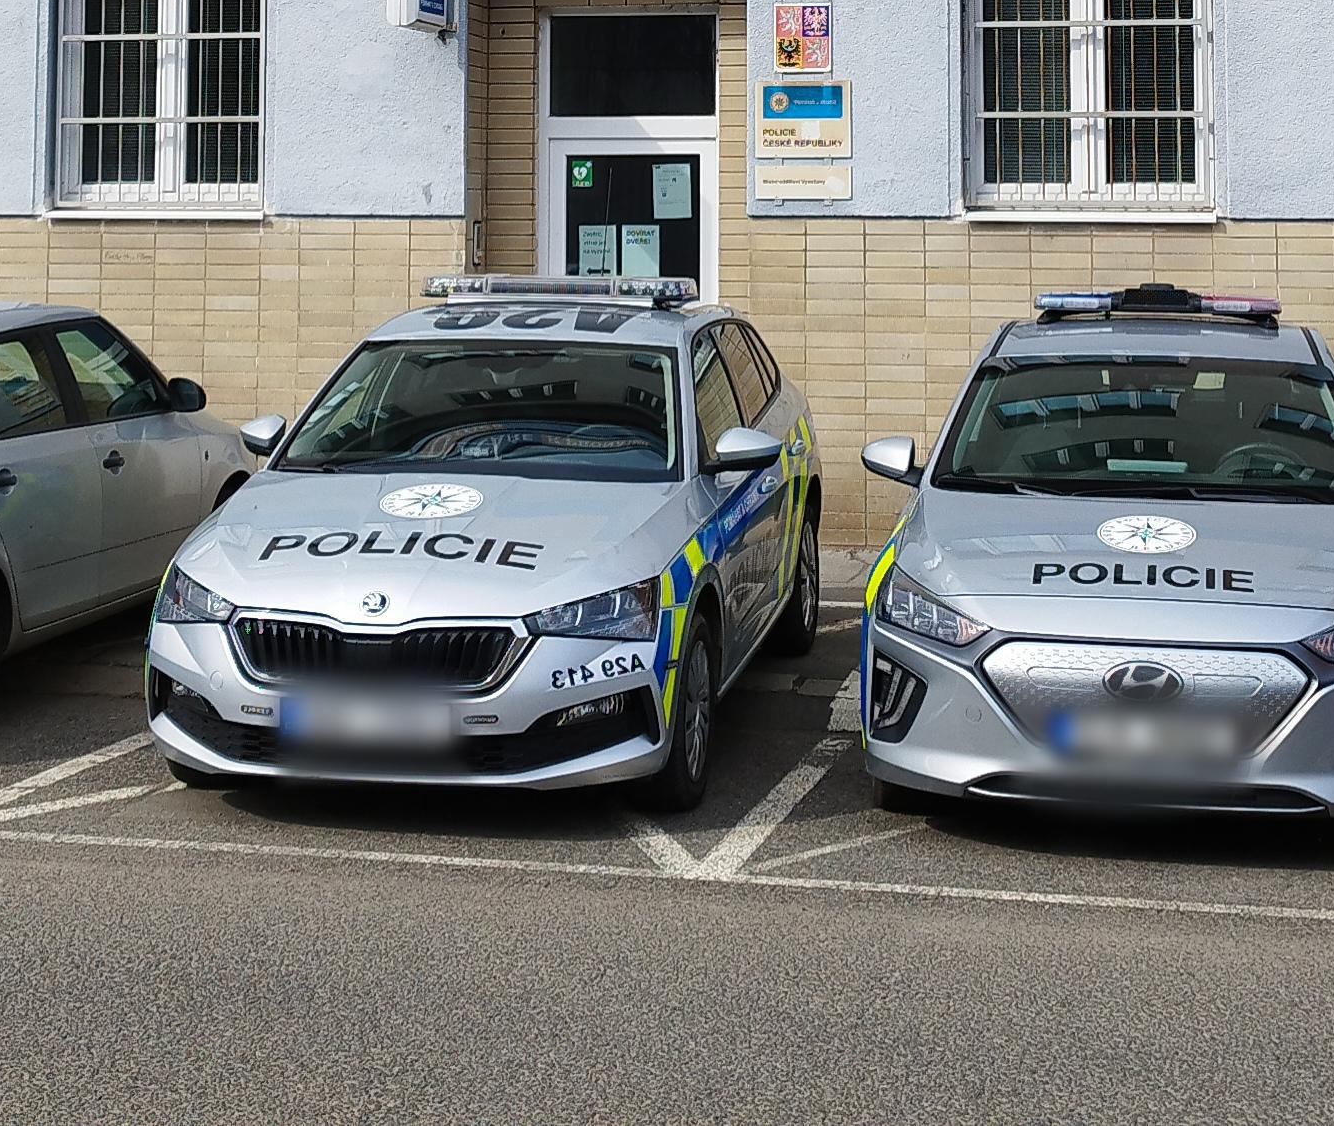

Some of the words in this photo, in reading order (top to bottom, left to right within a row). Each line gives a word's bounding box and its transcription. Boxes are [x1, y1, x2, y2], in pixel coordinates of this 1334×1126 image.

[762, 129, 797, 137] POLICIE
[762, 138, 791, 147] ČESKÉ
[794, 139, 843, 148] REPUBLIKY
[258, 530, 545, 571] POLICIE
[1032, 562, 1255, 593] POLICIE
